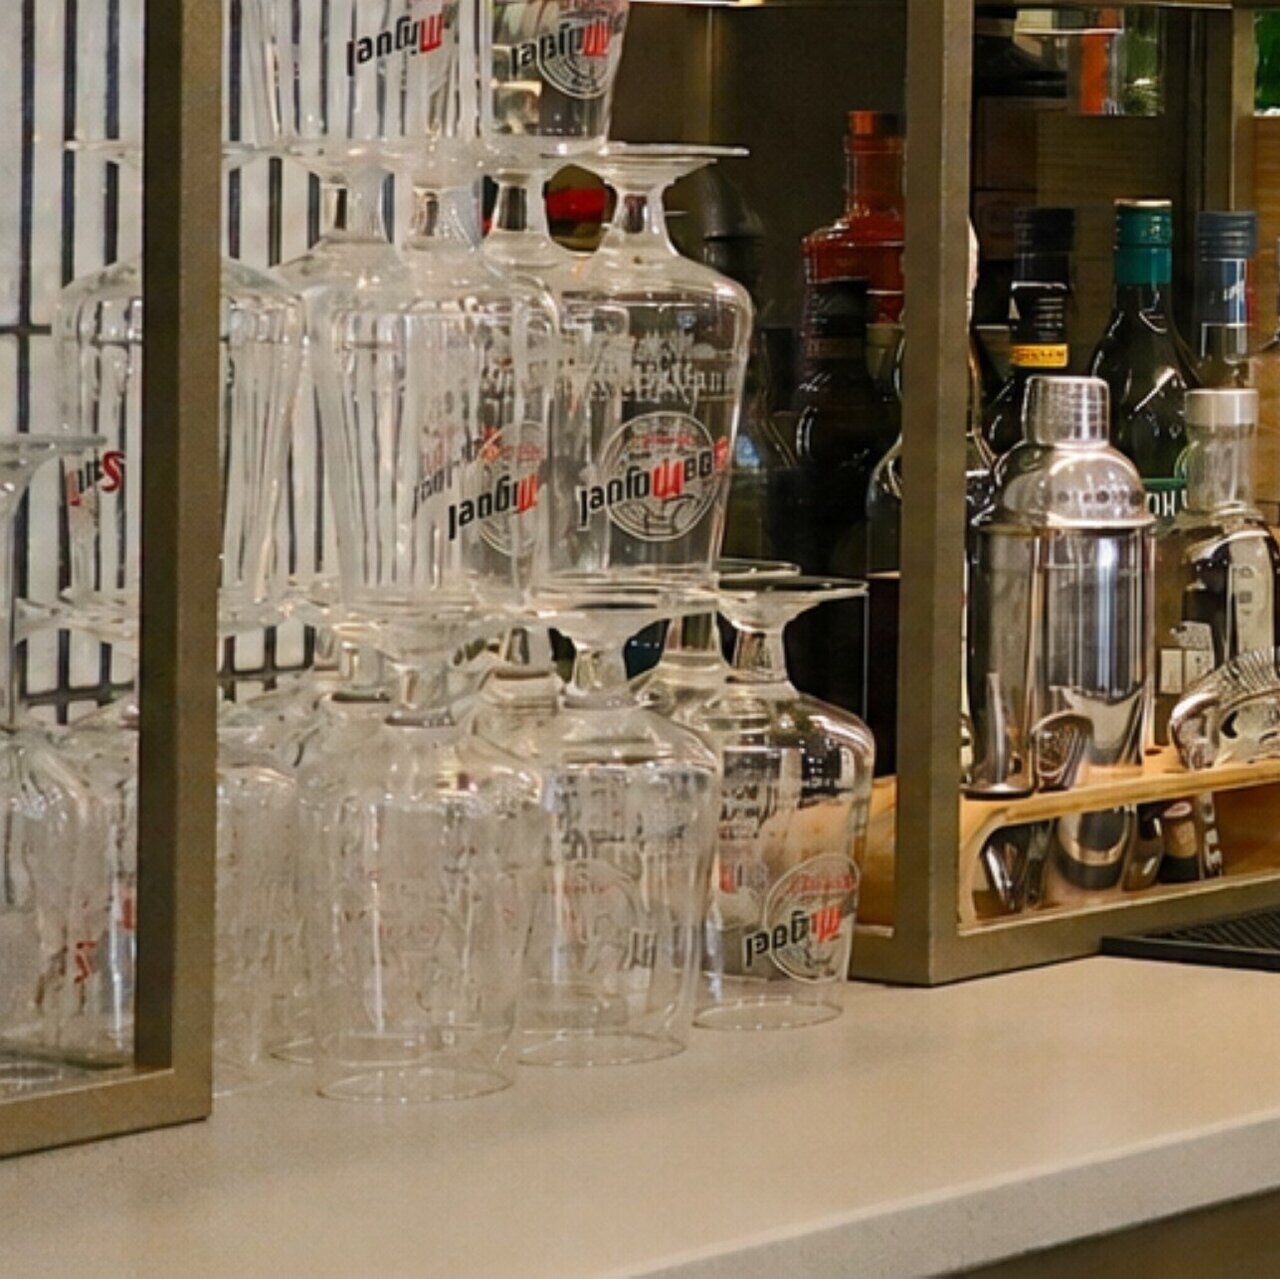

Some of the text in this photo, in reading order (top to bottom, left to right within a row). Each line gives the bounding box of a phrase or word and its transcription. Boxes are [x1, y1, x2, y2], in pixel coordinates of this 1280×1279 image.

[346, 13, 444, 77] Miguel
[448, 474, 540, 540] Miguel
[577, 459, 685, 531] Miguel
